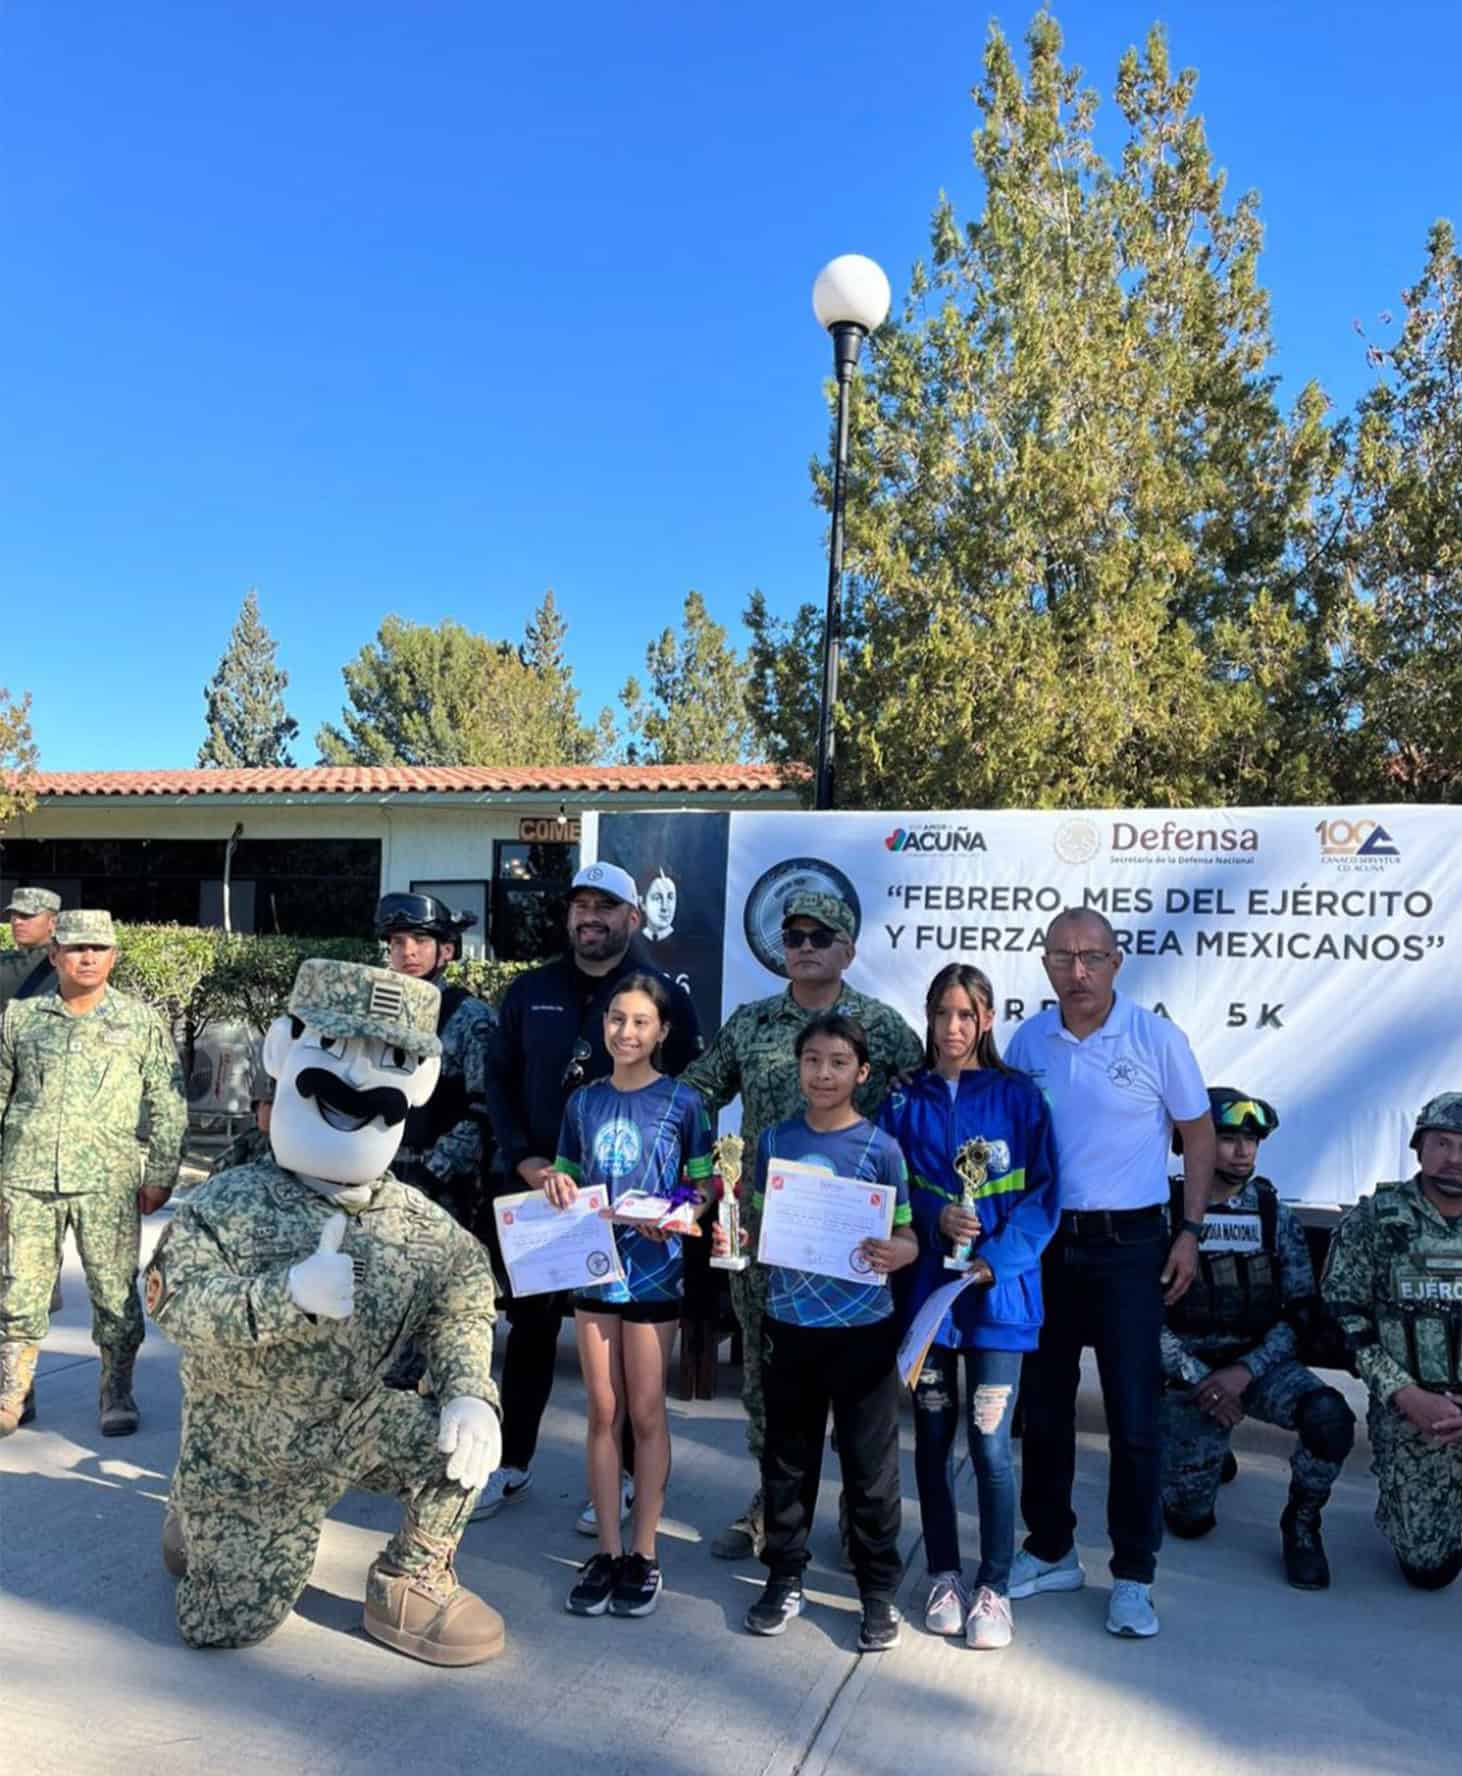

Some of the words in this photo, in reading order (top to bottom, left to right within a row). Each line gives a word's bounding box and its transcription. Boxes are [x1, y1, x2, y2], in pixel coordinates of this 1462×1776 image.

[903, 825, 988, 852] ACUÑA
[1112, 821, 1260, 851] Defensa
[1083, 886, 1153, 914] MES
[1166, 888, 1235, 915] DEL
[1248, 882, 1433, 918] EJÉRCITO
[885, 924, 906, 950] Y
[1111, 928, 1184, 957] REA
